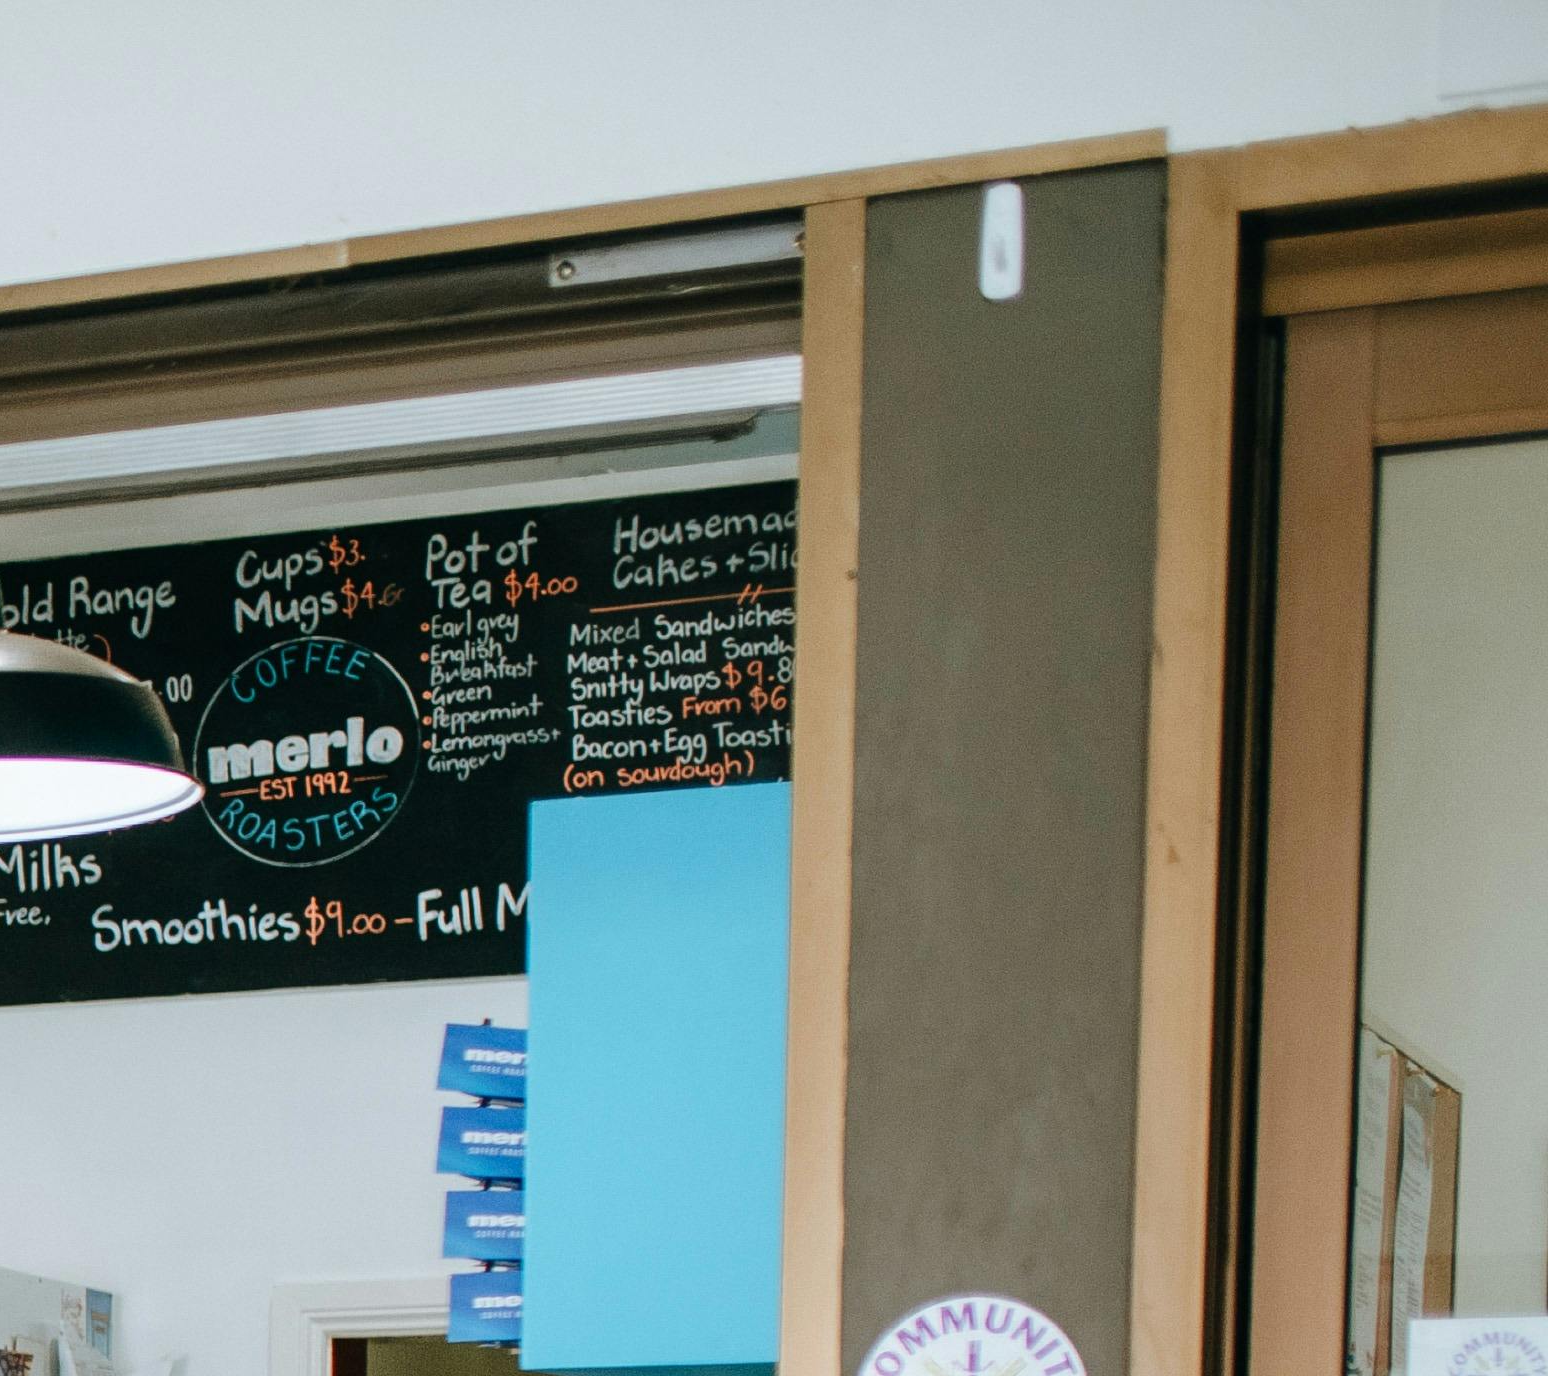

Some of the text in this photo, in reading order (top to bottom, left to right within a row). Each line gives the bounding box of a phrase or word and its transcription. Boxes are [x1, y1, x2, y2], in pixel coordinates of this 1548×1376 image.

[426, 520, 538, 580] Pot of
[236, 548, 323, 591] Cups
[431, 568, 578, 609] Tea $4.00
[613, 554, 718, 590] Cakes
[2, 584, 54, 628] old
[69, 577, 176, 638] Range
[234, 590, 338, 634] Mugs
[431, 609, 519, 643] Earl grey
[570, 603, 796, 646] Mixed Sandwiches
[232, 642, 370, 701] COFFEE
[430, 637, 503, 669] English
[430, 653, 538, 686] Breakfast
[567, 648, 624, 674] Meat
[643, 640, 706, 668] Salad
[431, 684, 492, 705] Green
[571, 671, 721, 706] Snitty Wraps
[432, 693, 543, 735] Peppermint
[568, 700, 673, 729] Toasties
[682, 696, 741, 719] From
[208, 716, 403, 784] merlo
[712, 720, 791, 747] Toasti
[260, 771, 352, 800] EST 1992
[428, 753, 490, 781] Ginger
[564, 751, 755, 793] (on sourdough)
[219, 787, 397, 850] ROASTERS
[92, 899, 300, 952] Smoothies
[305, 896, 386, 946] $9.00
[417, 886, 483, 941] Full
[464, 1049, 526, 1065] mer
